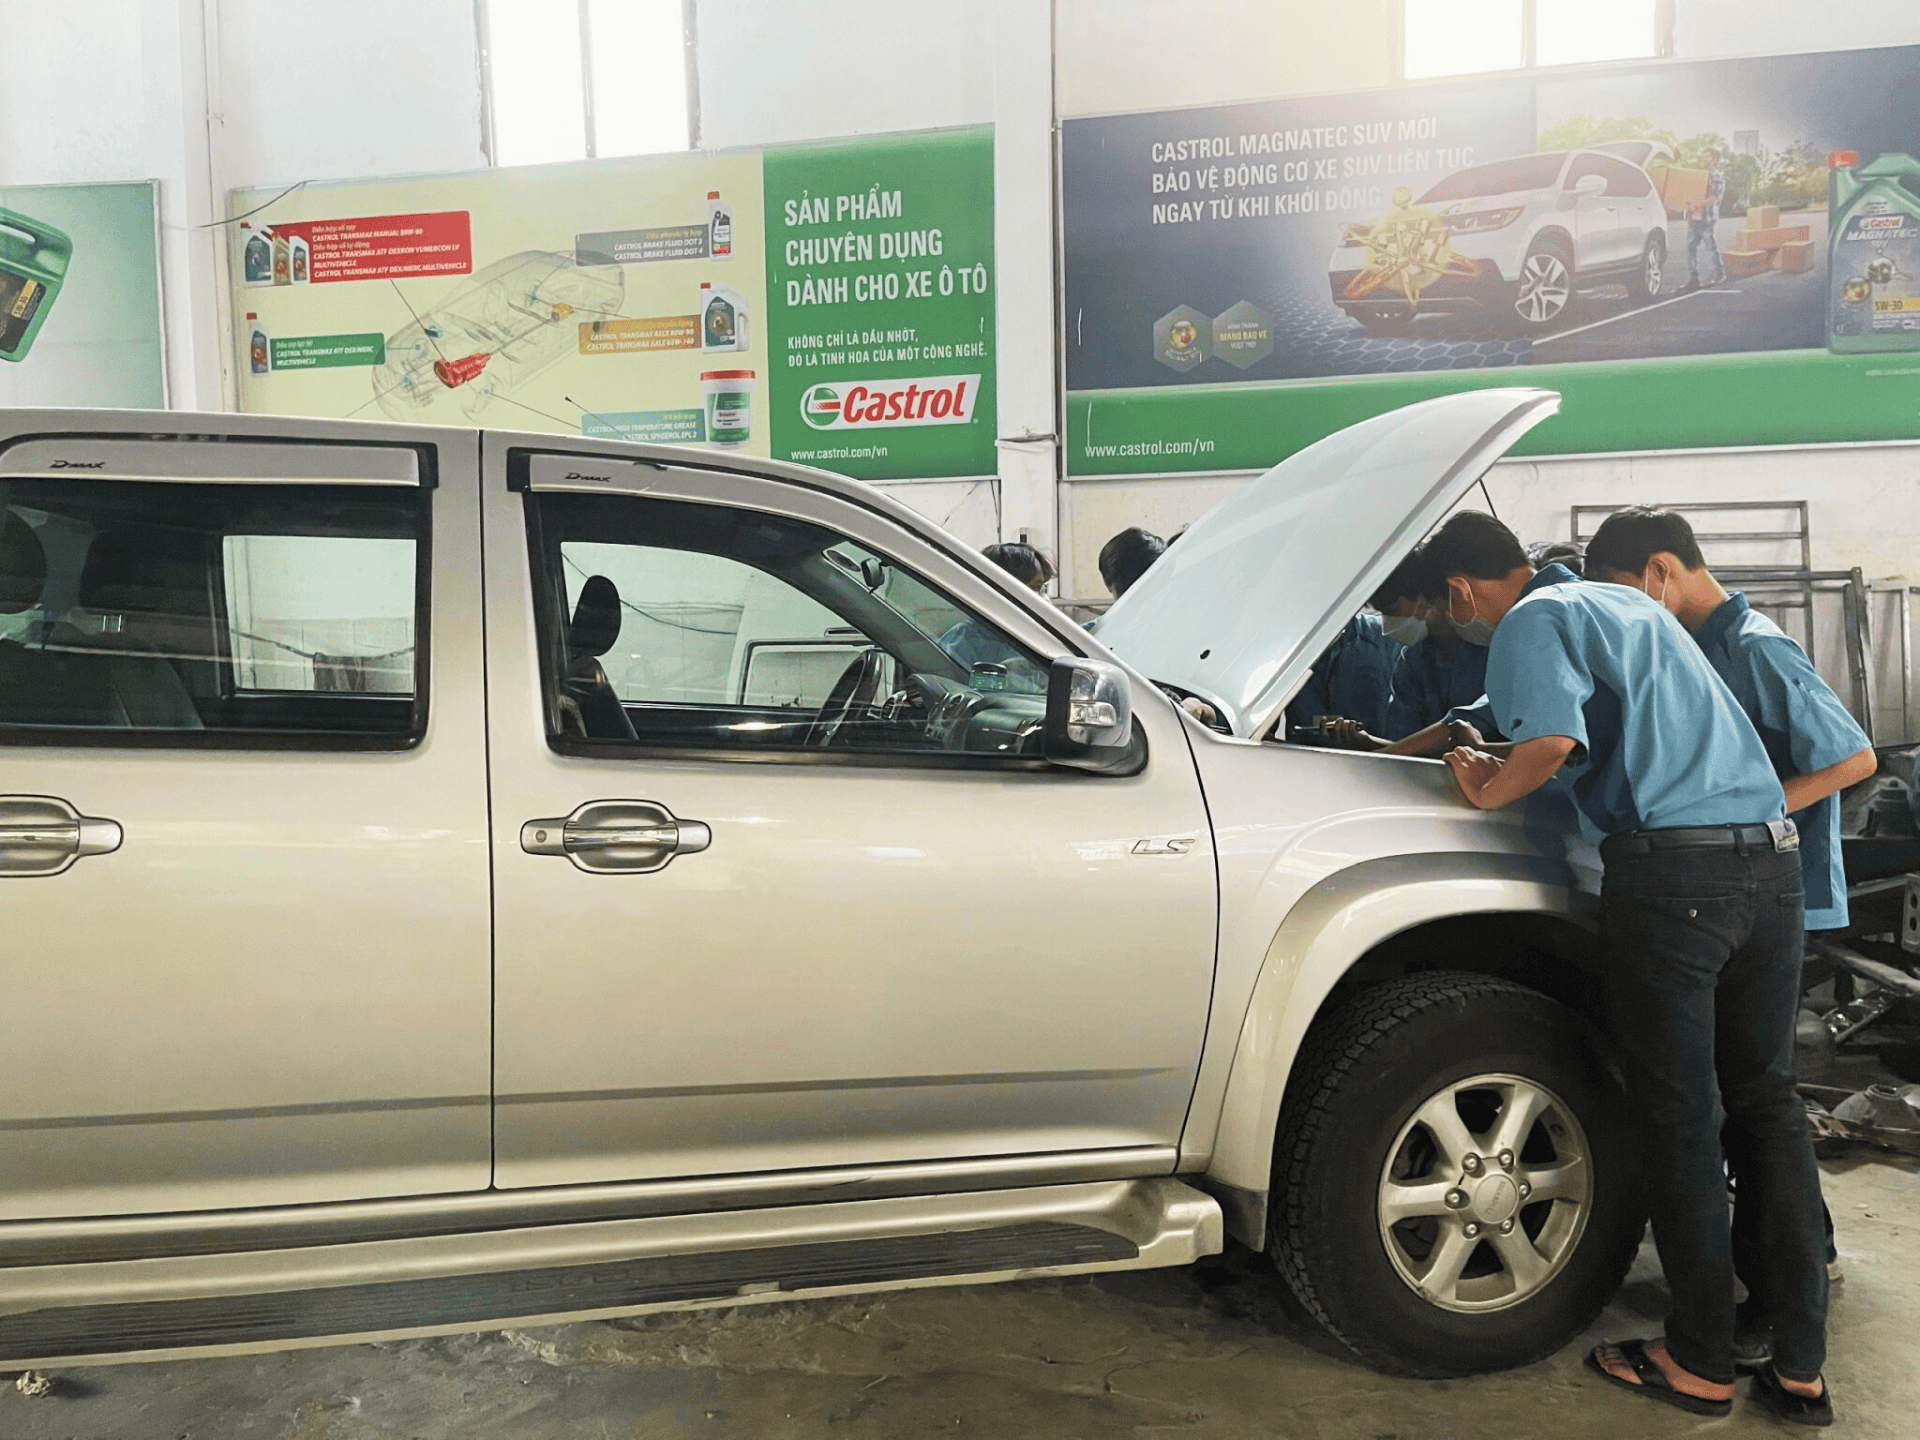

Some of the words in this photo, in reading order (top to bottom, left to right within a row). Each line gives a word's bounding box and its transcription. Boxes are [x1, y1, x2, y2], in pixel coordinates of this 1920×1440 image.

[1152, 137, 1235, 163] CASTROL
[1239, 126, 1348, 155] MAGNATEC
[1353, 121, 1392, 145] SUV
[1398, 113, 1437, 142] MỚI
[1152, 166, 1191, 194] BẢO
[1196, 165, 1219, 192] VỆ
[1224, 163, 1278, 190] ĐỘNG
[1283, 159, 1309, 183] CƠ
[1314, 159, 1337, 180] XE
[1343, 154, 1382, 178] SUV
[1387, 148, 1430, 174] LIÊN
[784, 189, 830, 226] SẢN
[836, 182, 902, 222] PHẨM
[1152, 201, 1204, 225] NGAY
[1209, 194, 1234, 220] TỪ
[1238, 196, 1269, 218] KHI
[1275, 185, 1319, 215] KHỞI
[785, 231, 873, 267] CHUYÊN
[880, 229, 943, 263] DỤNG
[1847, 228, 1918, 240] MAGNATEC
[786, 273, 848, 307] DÀNH
[855, 273, 899, 301] CHO
[905, 270, 933, 298] XE
[939, 264, 954, 296] Ô
[958, 262, 987, 294] TÔ
[788, 334, 823, 349] KHÔNG
[826, 330, 844, 347] CHỈ
[847, 330, 859, 345] LÀ
[805, 351, 818, 366] LÀ
[821, 352, 845, 365] TINH
[848, 350, 870, 363] HOA
[873, 346, 894, 362] CỦA
[897, 345, 920, 362] MỘT
[923, 343, 952, 359] CÔNG
[843, 381, 967, 423] Castrol
[791, 446, 888, 460] www.castrol.com/vn
[1085, 438, 1214, 457] www.castrol.com/vn
[1131, 839, 1195, 854] LS
